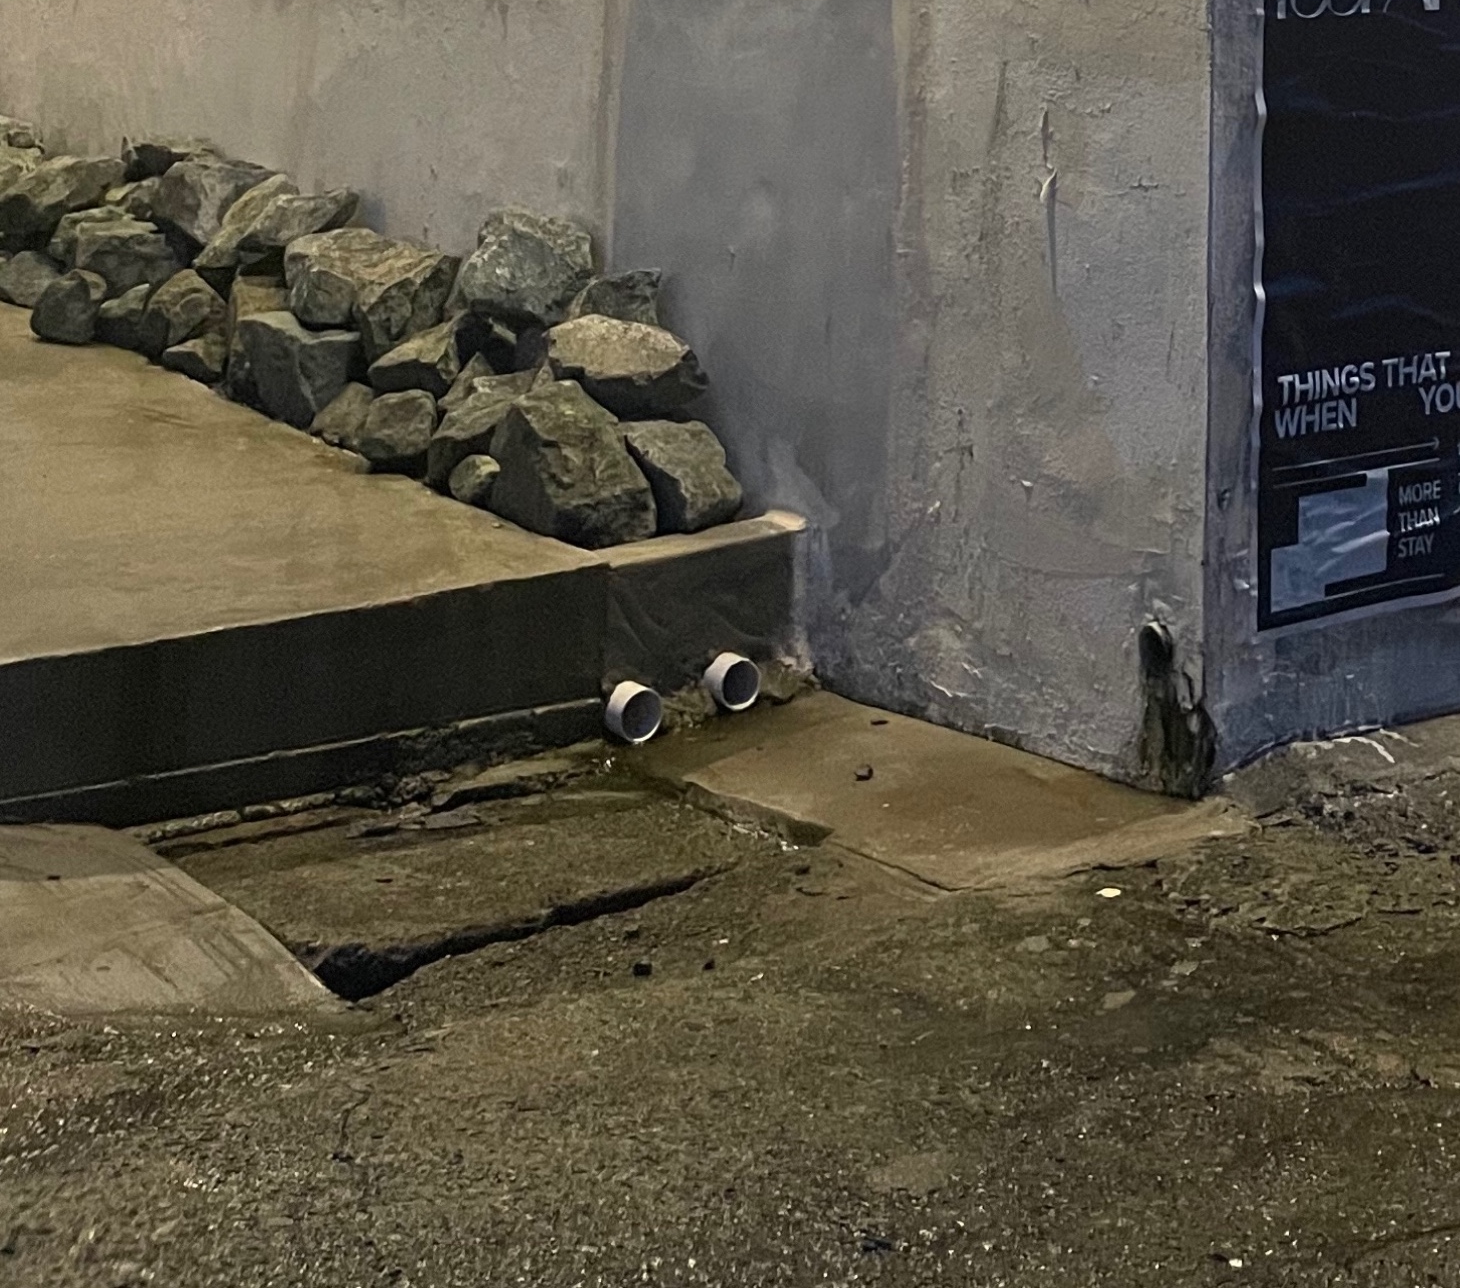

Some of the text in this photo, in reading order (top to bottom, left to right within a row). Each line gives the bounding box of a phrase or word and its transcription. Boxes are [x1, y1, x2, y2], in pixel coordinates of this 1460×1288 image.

[1278, 362, 1375, 406] THINGS
[1382, 351, 1451, 388] THAT
[1274, 398, 1357, 439] WHEN
[1398, 480, 1441, 506] MORE
[1398, 507, 1440, 534] THAN
[1398, 533, 1434, 558] STAY
